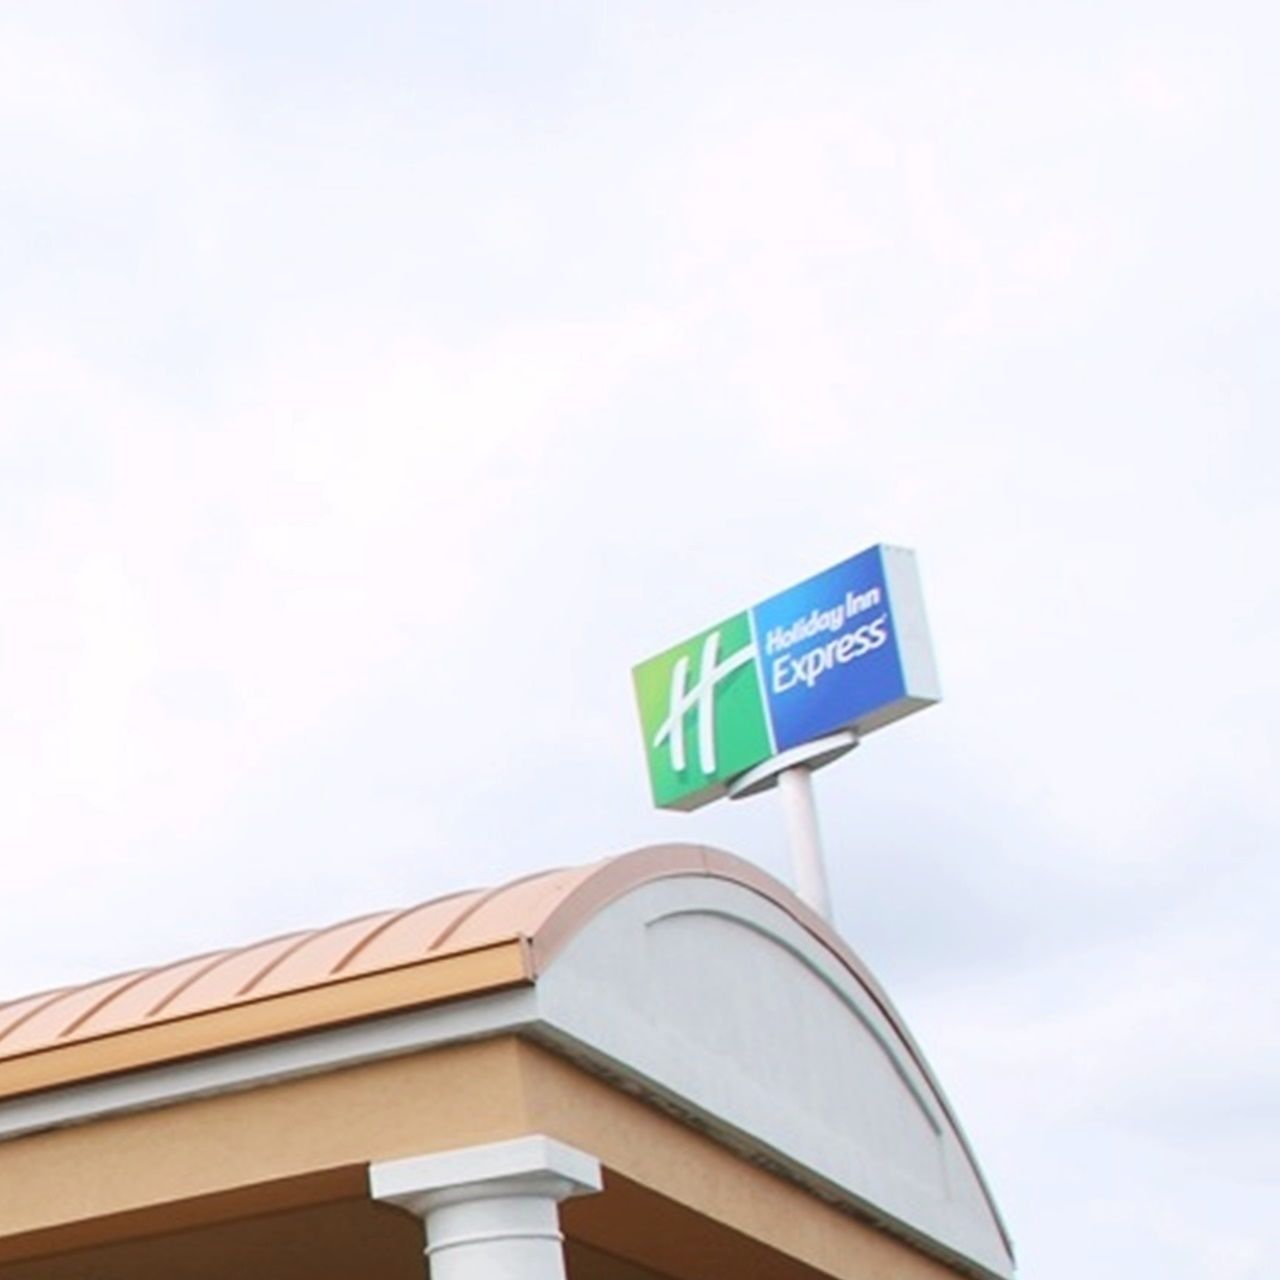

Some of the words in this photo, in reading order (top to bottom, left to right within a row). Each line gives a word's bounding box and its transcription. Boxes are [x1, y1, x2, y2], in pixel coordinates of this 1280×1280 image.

[765, 603, 845, 656] Holiday
[845, 587, 881, 618] Inn
[773, 616, 887, 694] Express
